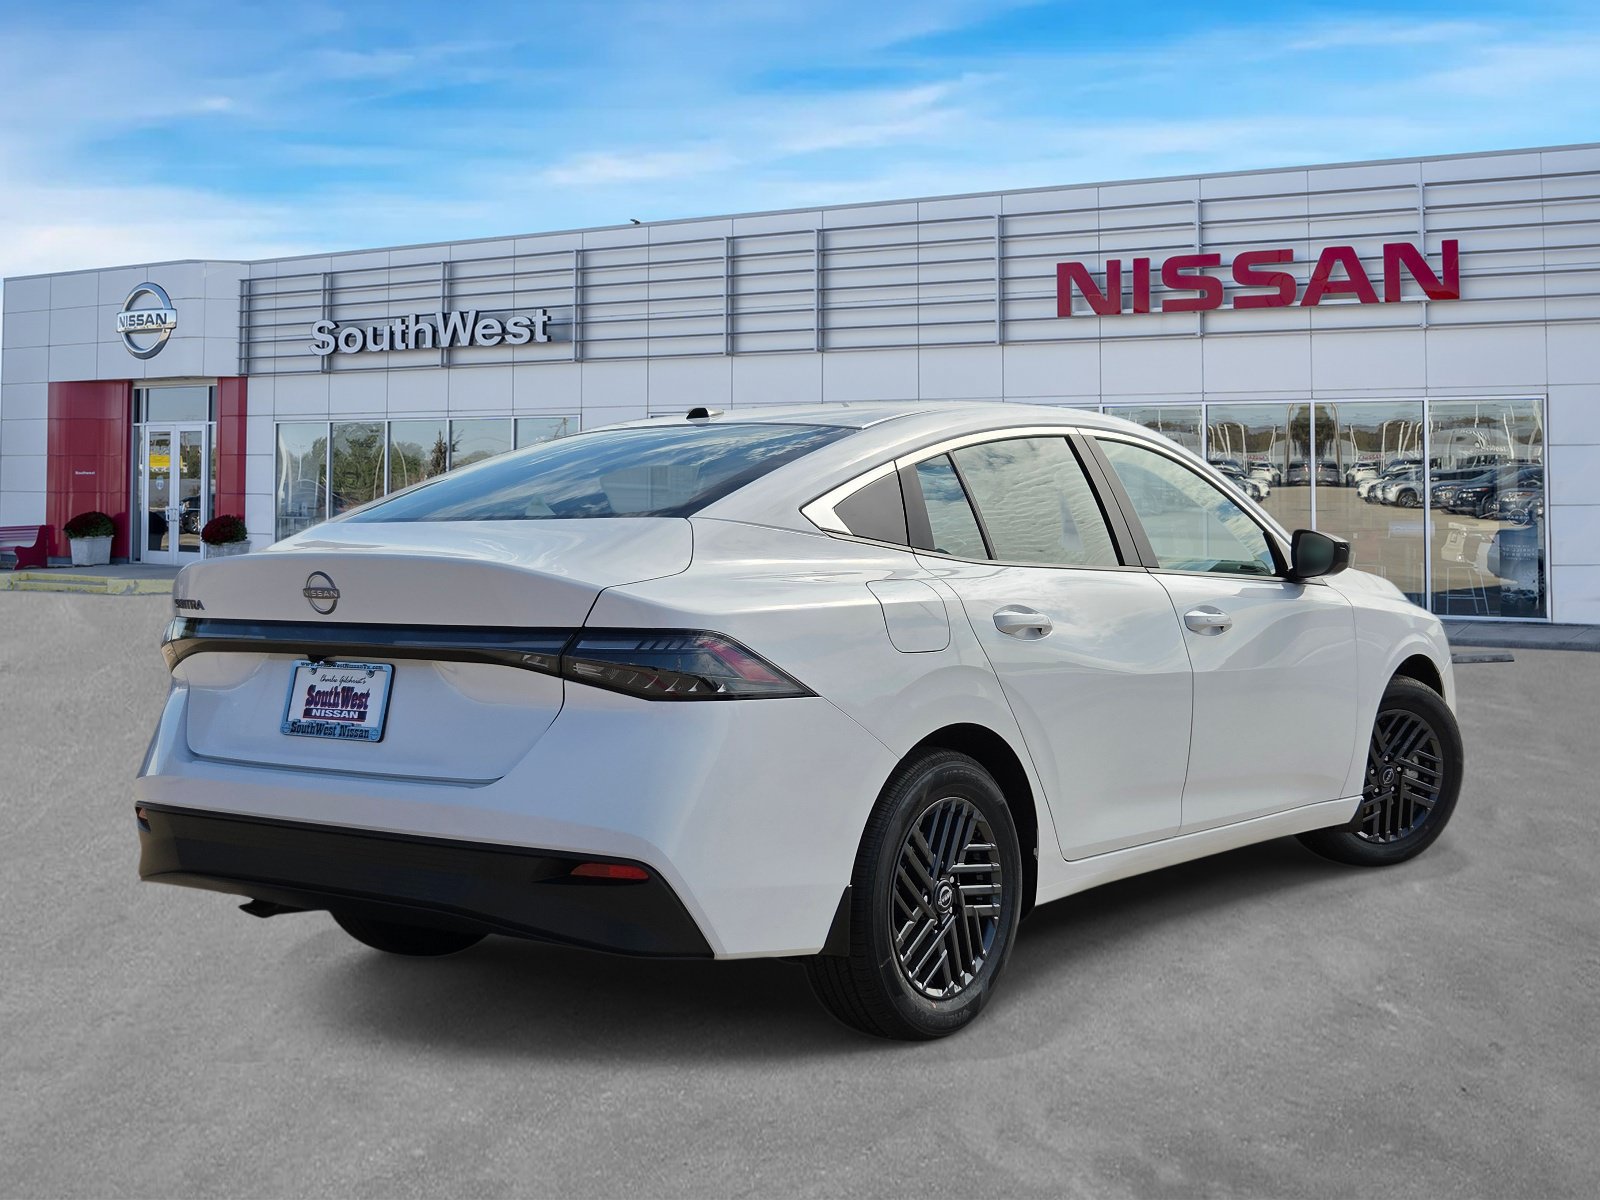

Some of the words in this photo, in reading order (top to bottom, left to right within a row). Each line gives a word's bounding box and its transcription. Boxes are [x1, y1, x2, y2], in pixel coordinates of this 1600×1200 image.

[1057, 239, 1460, 317] NISSAN
[118, 312, 167, 328] NISSAN
[308, 308, 551, 356] SouthWest
[303, 590, 338, 598] NISSAN
[304, 684, 370, 710] SouthWest
[312, 709, 358, 719] NISSAN
[290, 720, 338, 736] SouthWest
[339, 724, 369, 738] Nissan
